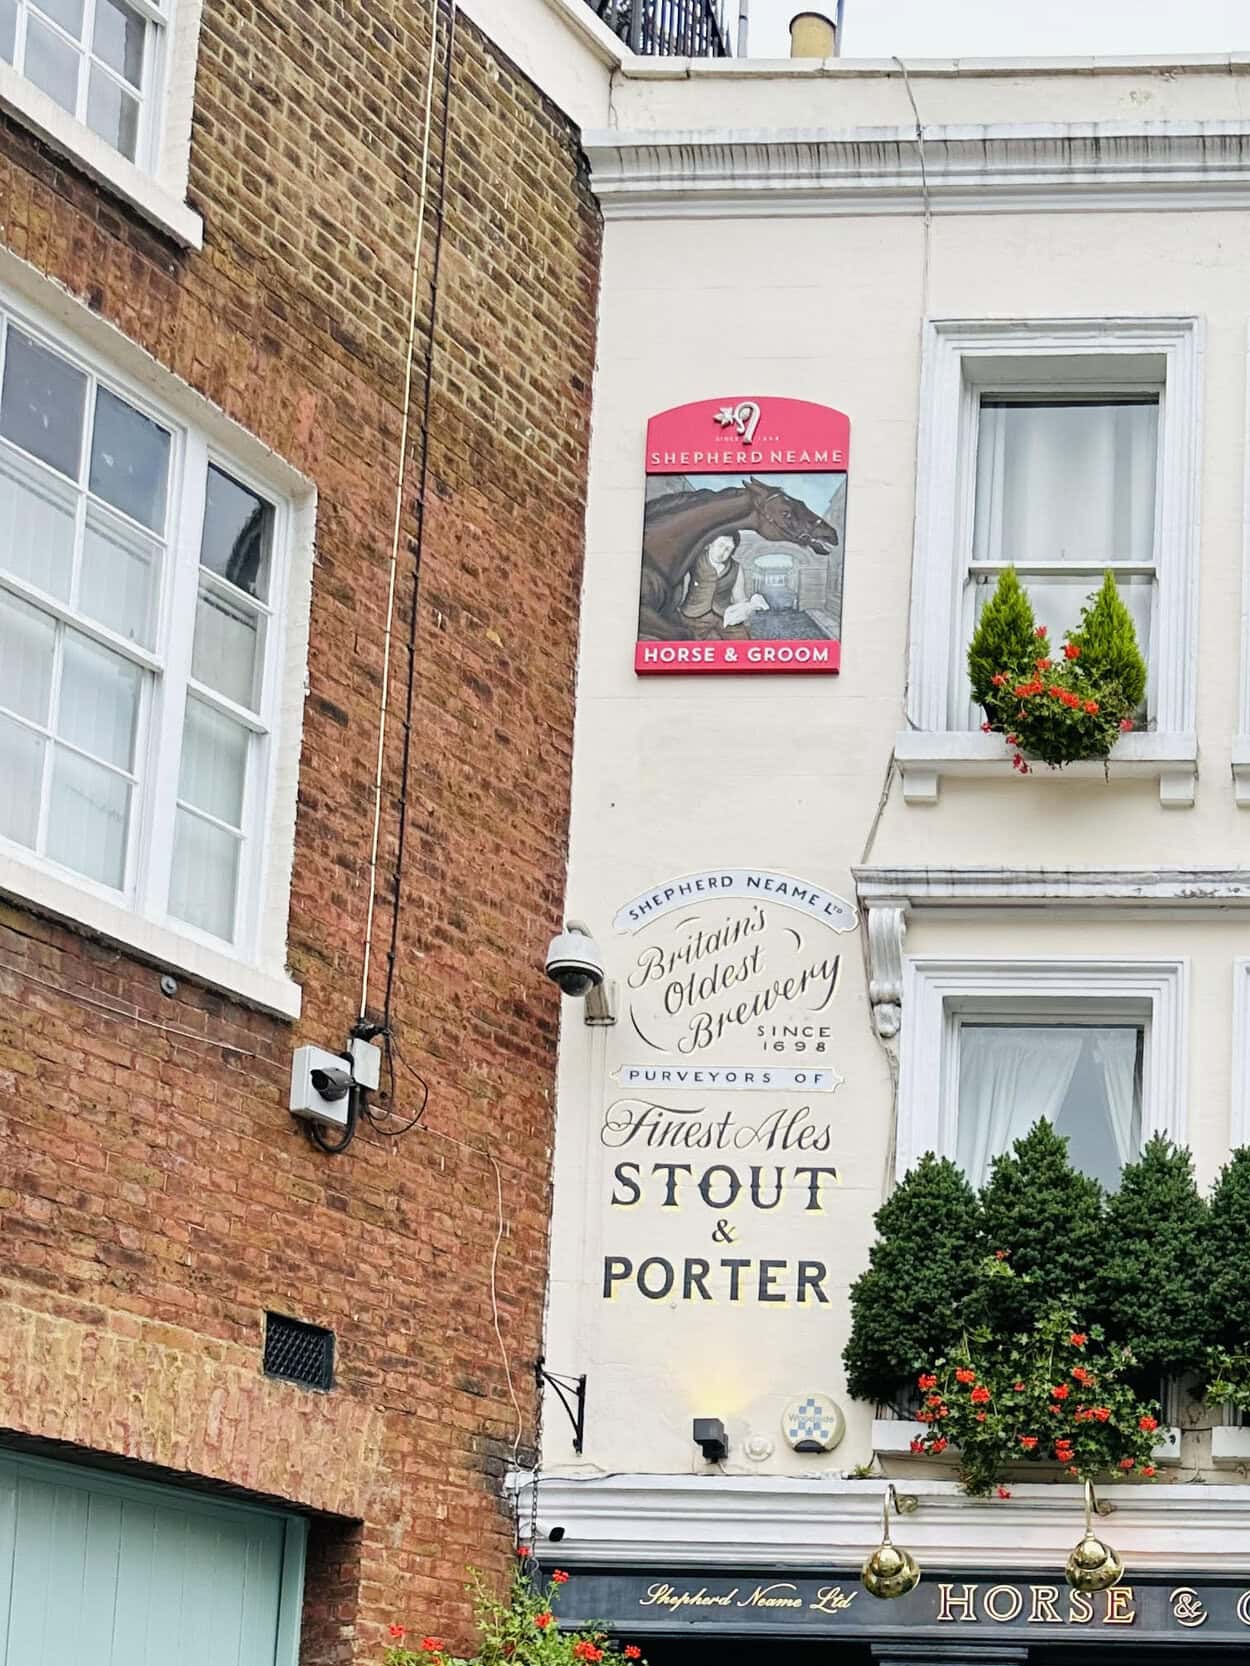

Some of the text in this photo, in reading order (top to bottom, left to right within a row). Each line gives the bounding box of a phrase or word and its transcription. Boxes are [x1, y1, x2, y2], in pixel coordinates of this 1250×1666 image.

[651, 449, 843, 466] SHEPHERD NEAME
[643, 646, 830, 663] HORSE & GROOM
[628, 875, 734, 921] SHEPHERD
[746, 875, 818, 906] NEAME
[627, 905, 767, 989] Britain's
[664, 945, 763, 1015] Oldest
[677, 955, 841, 1054] Brewery
[757, 1025, 831, 1038] SINCE
[763, 1040, 827, 1053] 1698
[629, 1069, 824, 1085] PURVEYORS OF
[600, 1098, 831, 1151] Finest Ales
[610, 1161, 838, 1210] STOUT
[711, 1219, 737, 1244] &
[602, 1255, 831, 1303] PORTER
[639, 1583, 858, 1614] Shepherd Neame Ltd
[937, 1583, 1136, 1624] HORSE
[1169, 1587, 1208, 1627] &
